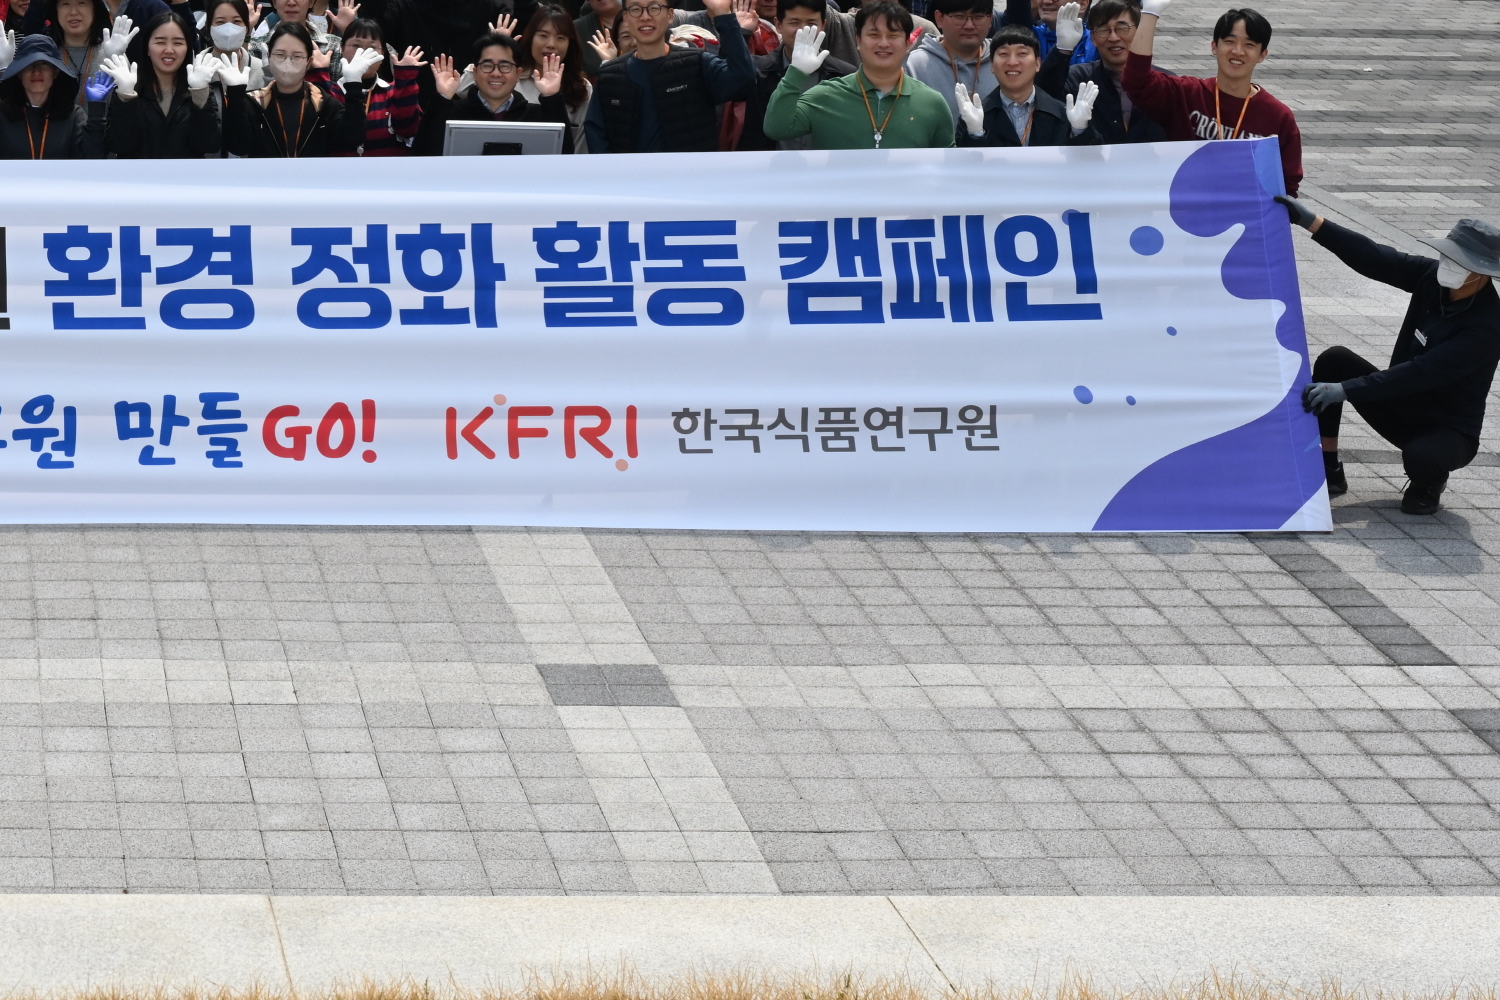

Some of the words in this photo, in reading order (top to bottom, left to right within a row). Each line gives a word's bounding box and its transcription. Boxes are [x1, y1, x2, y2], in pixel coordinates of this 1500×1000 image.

[43, 224, 255, 330] 환경
[291, 222, 506, 330] 정화
[532, 219, 747, 328] 활동
[778, 211, 1103, 325] 캠페인
[445, 396, 640, 469] KFRI
[671, 404, 1000, 455] 한국식품연구원
